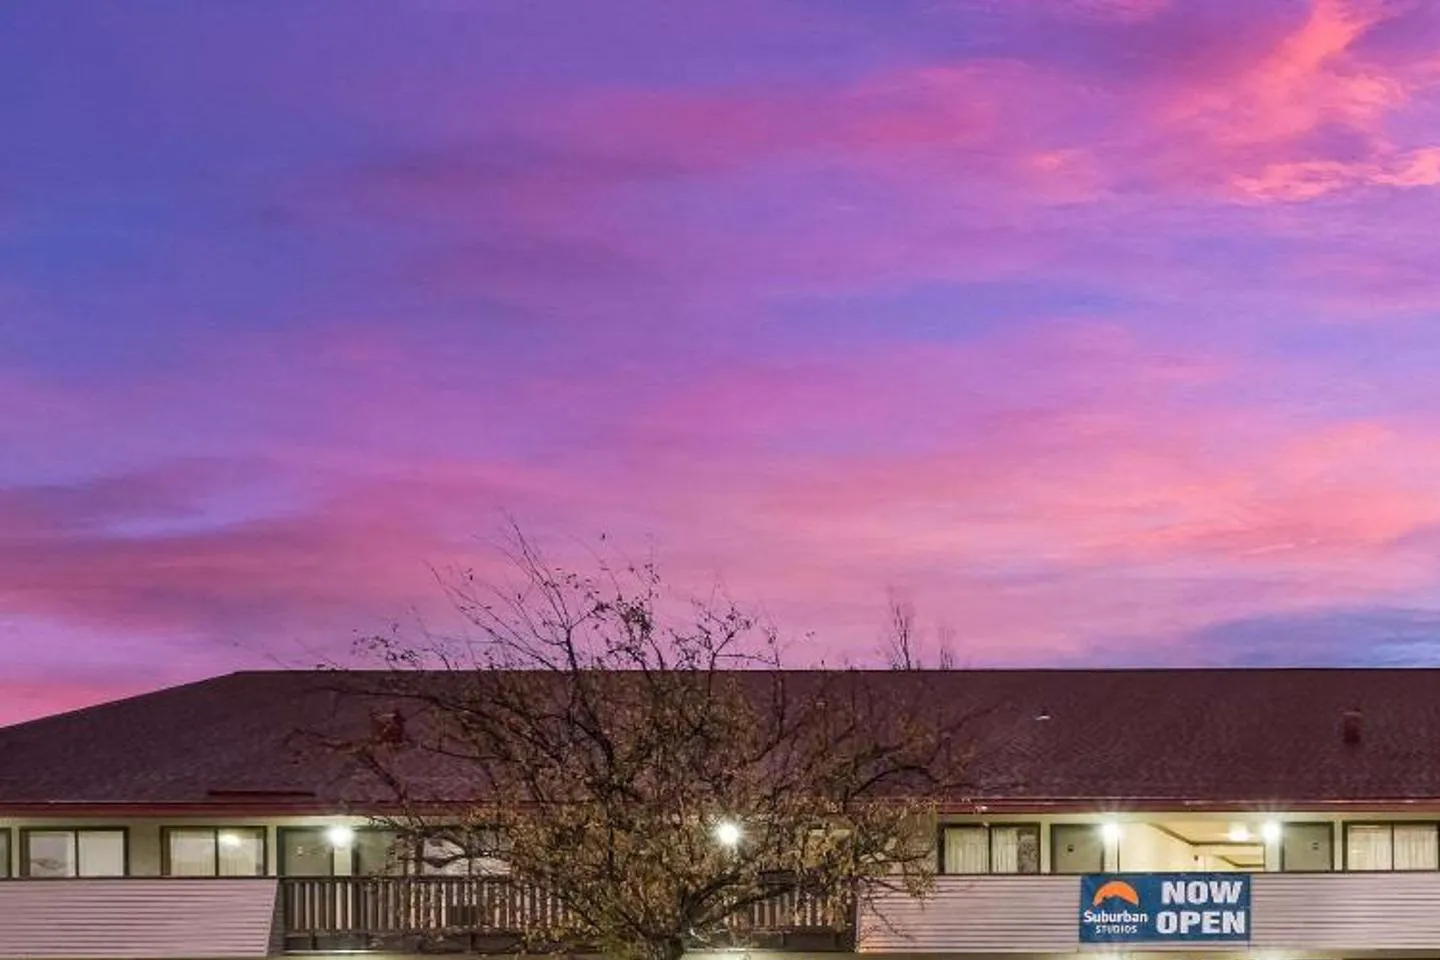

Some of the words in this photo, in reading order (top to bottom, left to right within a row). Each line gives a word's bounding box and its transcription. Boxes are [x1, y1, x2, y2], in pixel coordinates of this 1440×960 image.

[1161, 880, 1243, 905] NOW
[1083, 910, 1148, 923] Suburban
[1155, 911, 1245, 934] OPEN
[1095, 925, 1138, 934] STUDIOS
